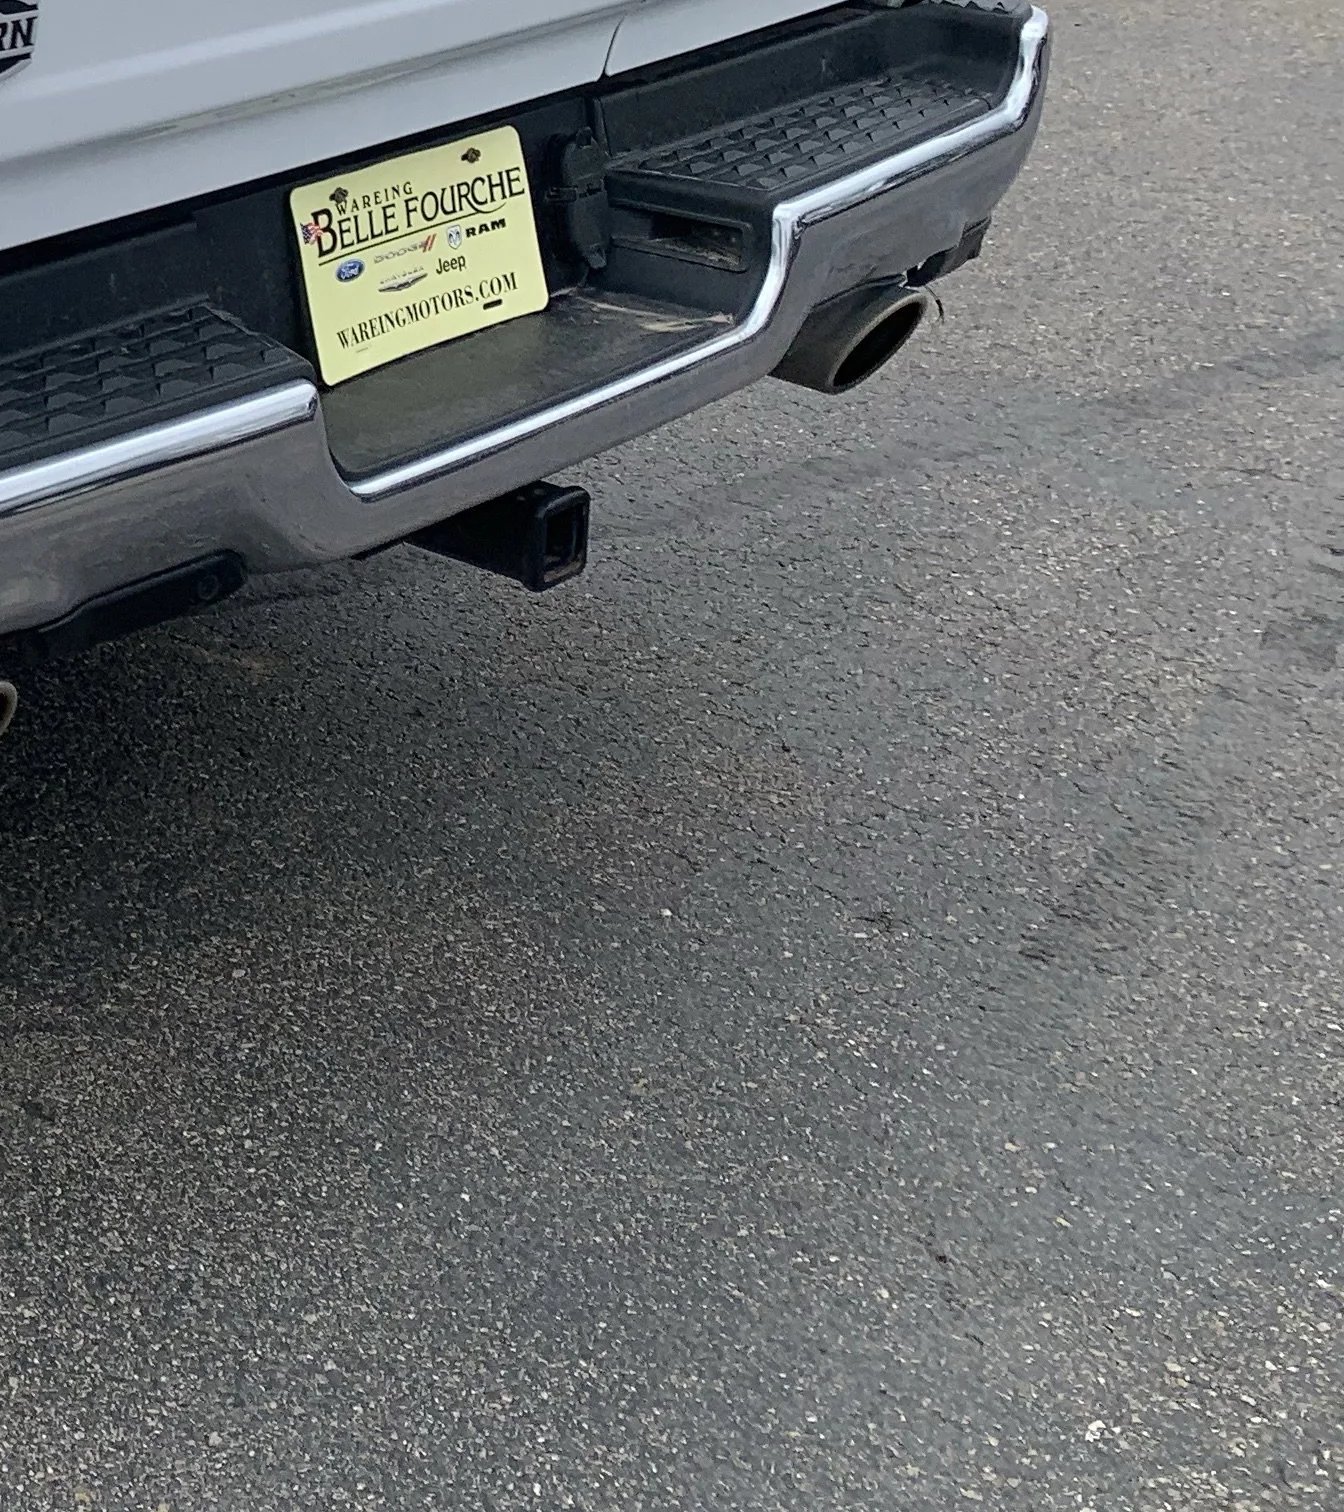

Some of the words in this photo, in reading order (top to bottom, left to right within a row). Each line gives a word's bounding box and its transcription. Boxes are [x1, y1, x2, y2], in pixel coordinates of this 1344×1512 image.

[311, 204, 399, 258] BELLE
[404, 167, 526, 228] FOURCHE
[335, 181, 413, 217] WAREING
[464, 217, 507, 239] RAM
[435, 255, 467, 275] Jeep
[336, 271, 519, 349] WAREINGMOTORS.COM
